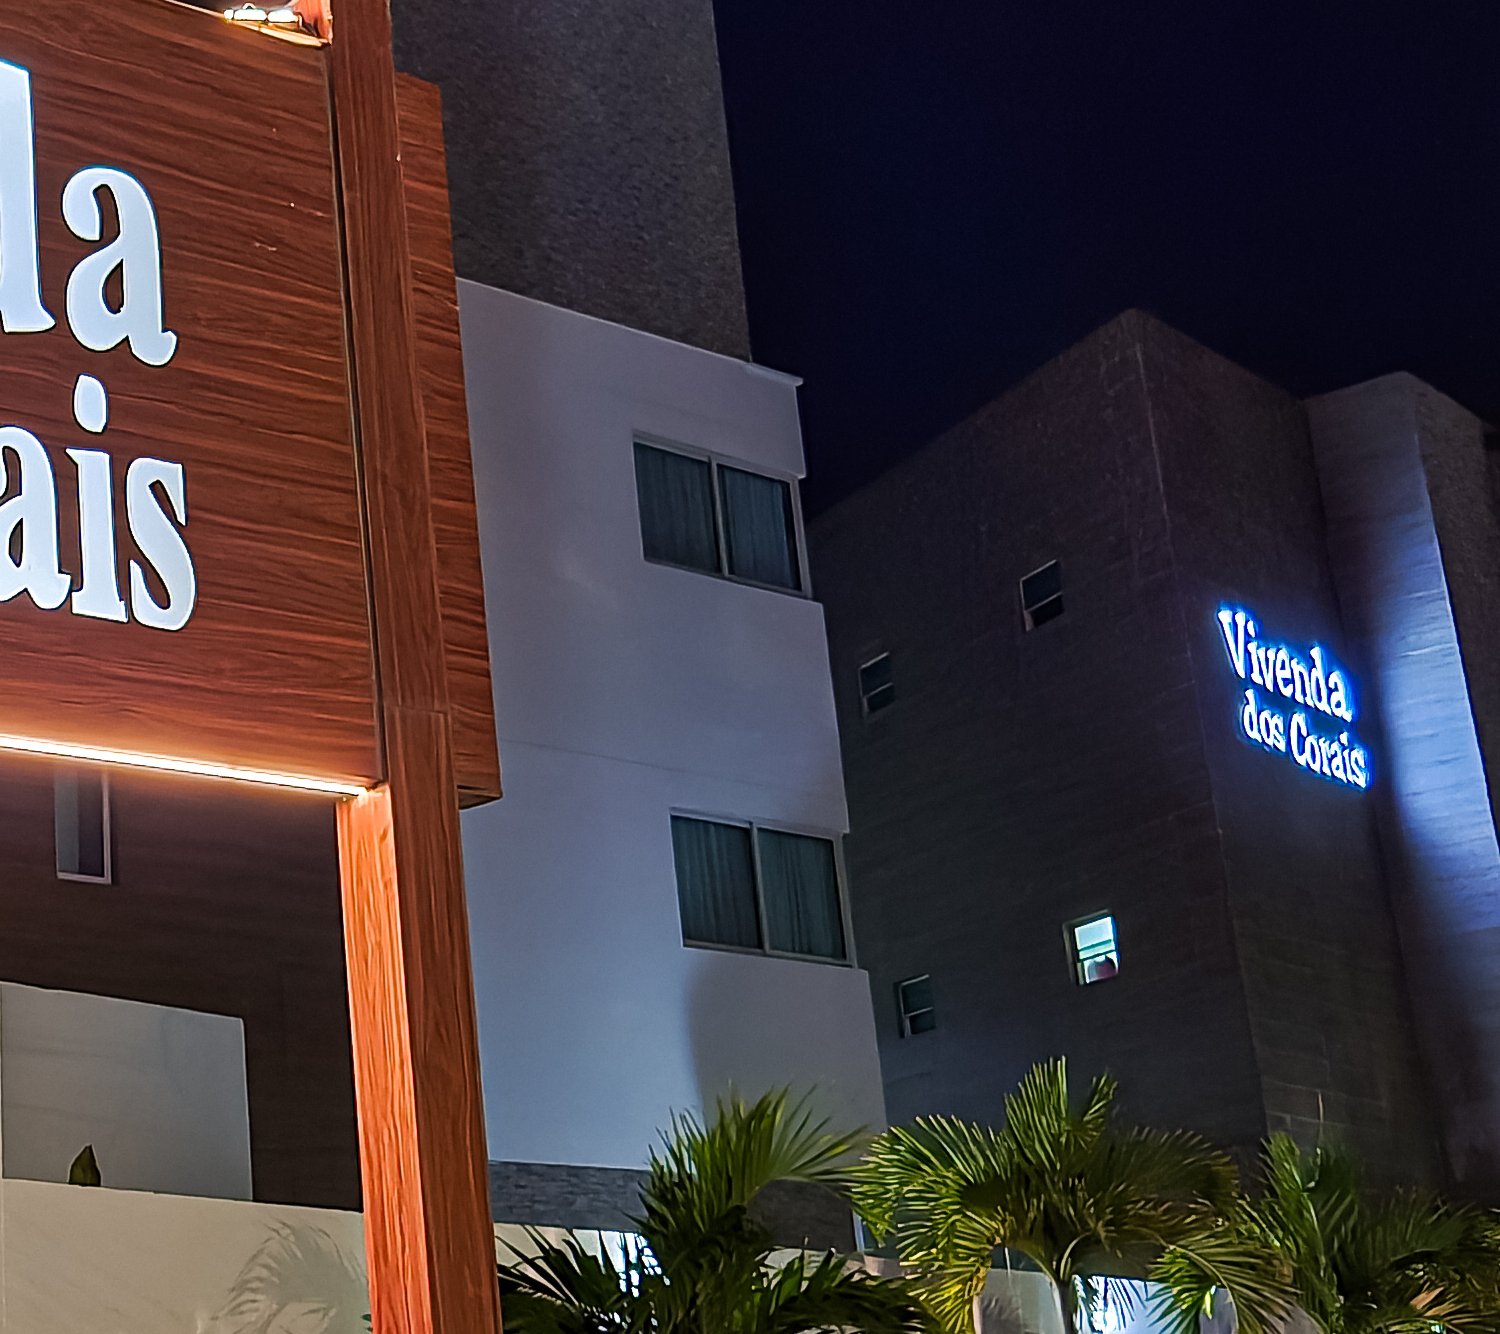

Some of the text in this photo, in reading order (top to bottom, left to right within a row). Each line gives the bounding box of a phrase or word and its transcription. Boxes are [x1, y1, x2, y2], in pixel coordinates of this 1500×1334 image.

[1216, 608, 1353, 723] Vivenda
[1243, 688, 1367, 789] dos Corais
